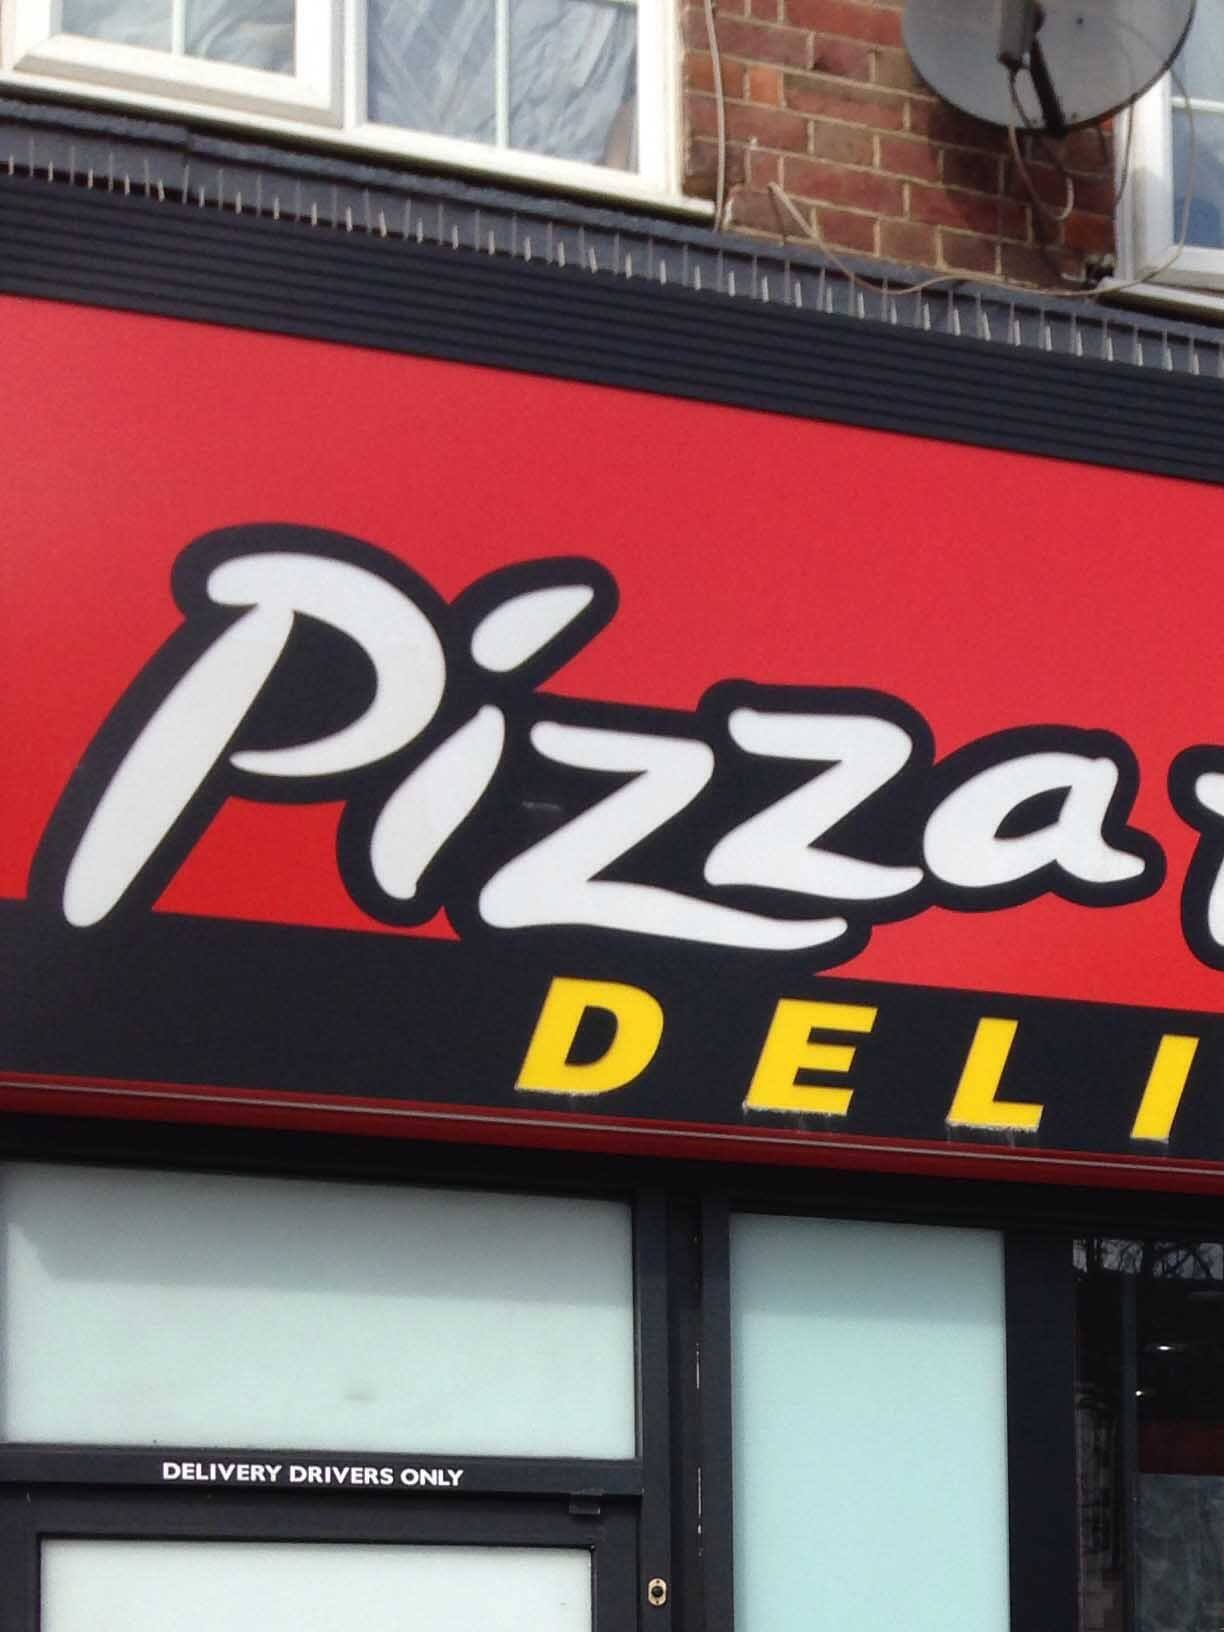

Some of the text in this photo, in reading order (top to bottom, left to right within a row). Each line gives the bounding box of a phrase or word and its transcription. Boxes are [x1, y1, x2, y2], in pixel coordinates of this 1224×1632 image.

[60, 546, 1149, 954] Pizza
[162, 1461, 464, 1487] DELIVERY DRIVERS ONLY
